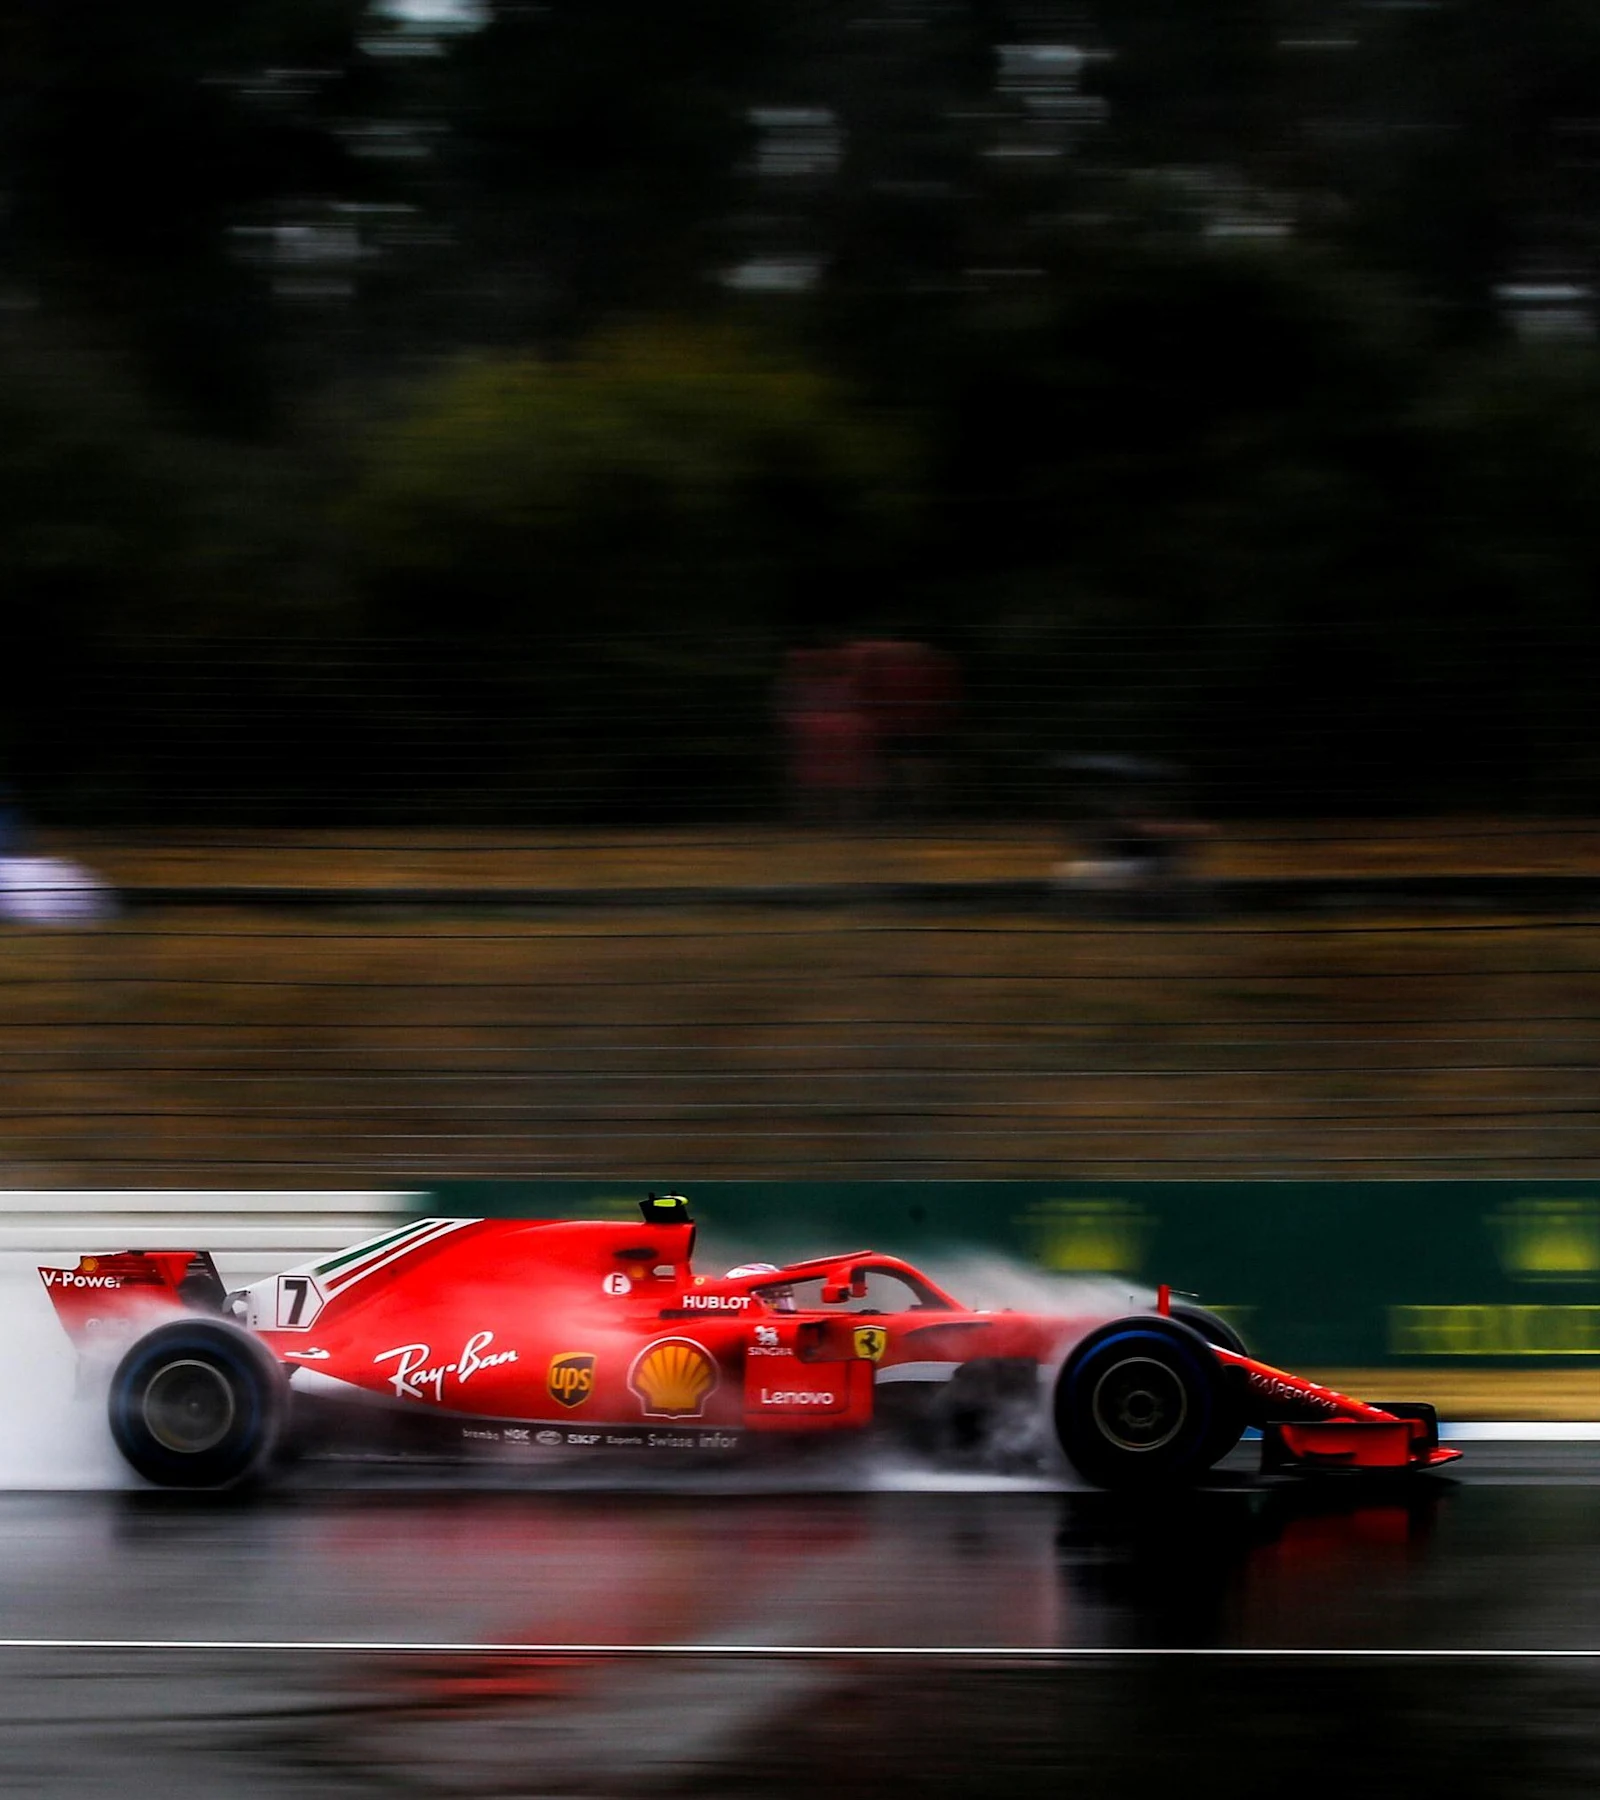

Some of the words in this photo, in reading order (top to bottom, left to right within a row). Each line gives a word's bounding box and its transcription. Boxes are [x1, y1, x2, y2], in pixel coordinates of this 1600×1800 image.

[611, 1274, 623, 1293] E
[284, 1279, 308, 1325] 7
[682, 1295, 751, 1309] HUBLOT
[747, 1346, 794, 1356] SINGHA
[552, 1366, 591, 1399] ups
[760, 1387, 834, 1405] Lenovo
[567, 1433, 601, 1444] SKF
[648, 1433, 693, 1447] Swisse
[699, 1432, 738, 1448] infor
